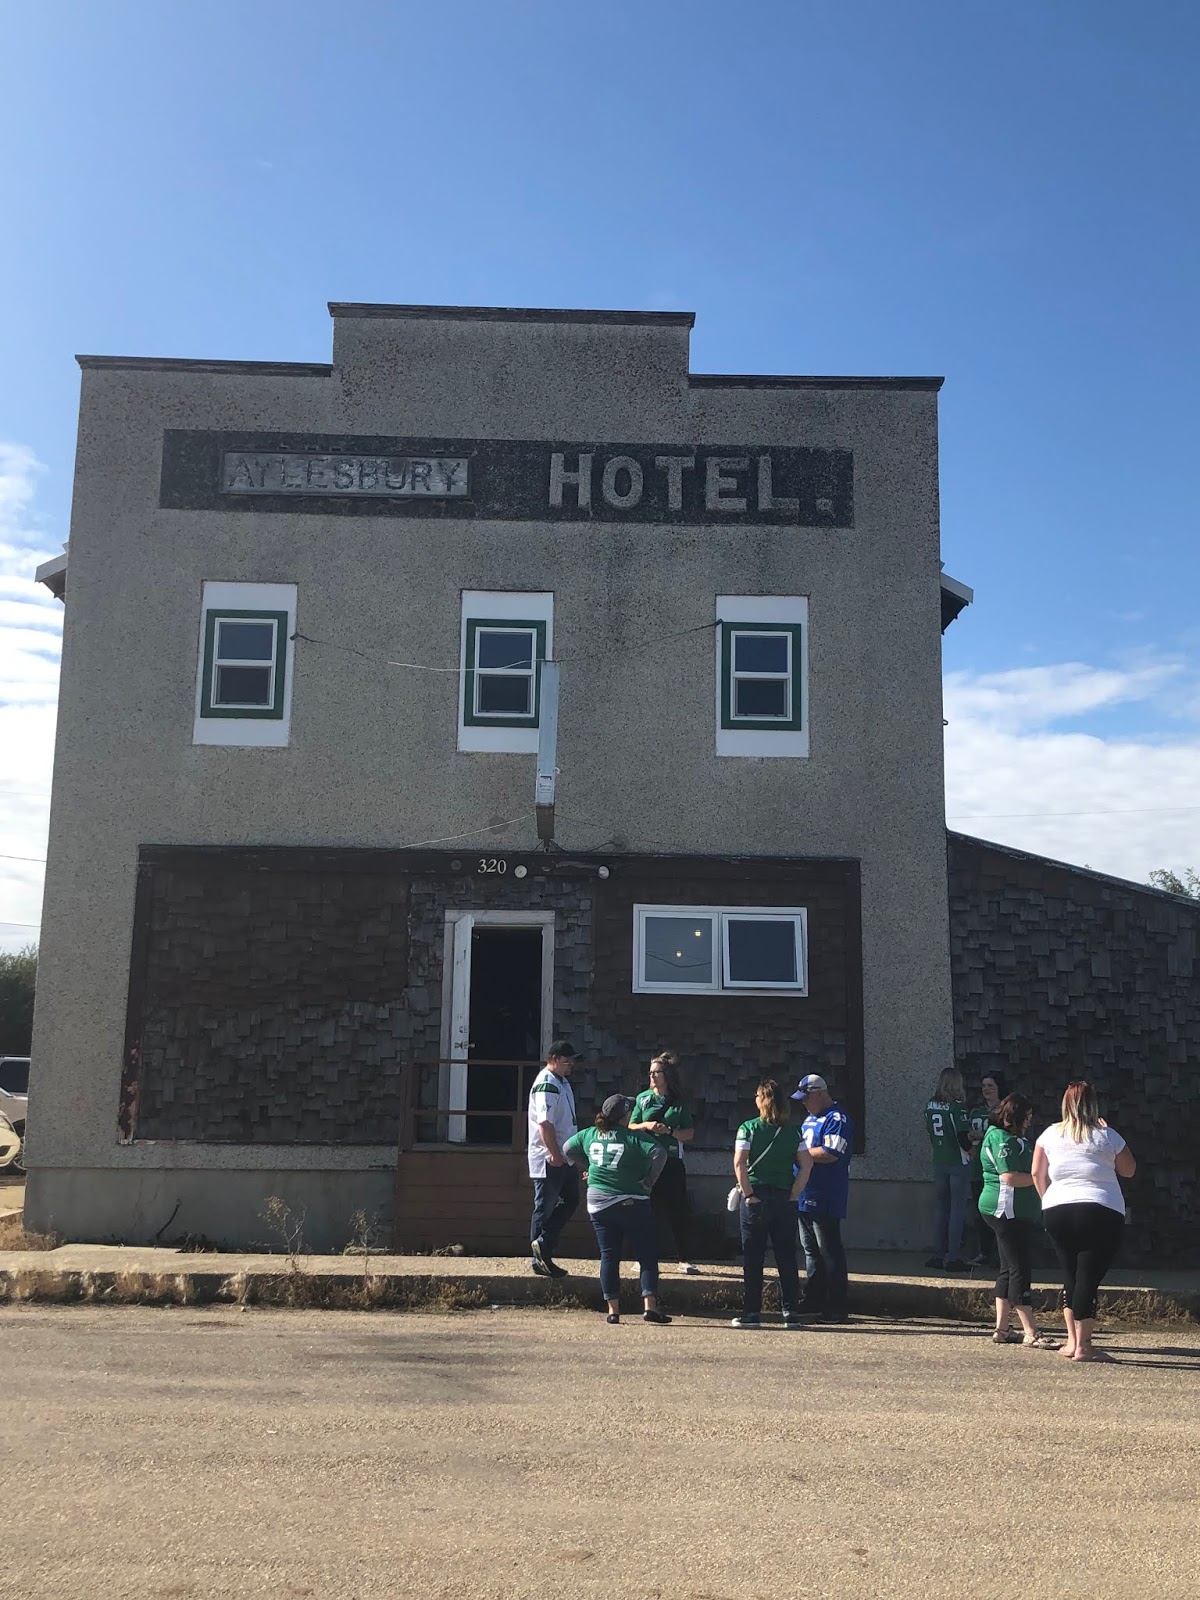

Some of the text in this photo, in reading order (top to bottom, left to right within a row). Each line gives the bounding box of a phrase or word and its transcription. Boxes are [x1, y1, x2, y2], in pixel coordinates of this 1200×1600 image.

[229, 457, 462, 492] AYLESBURY
[477, 858, 507, 875] 320
[931, 1113, 944, 1137] 2
[588, 1141, 625, 1169] 97
